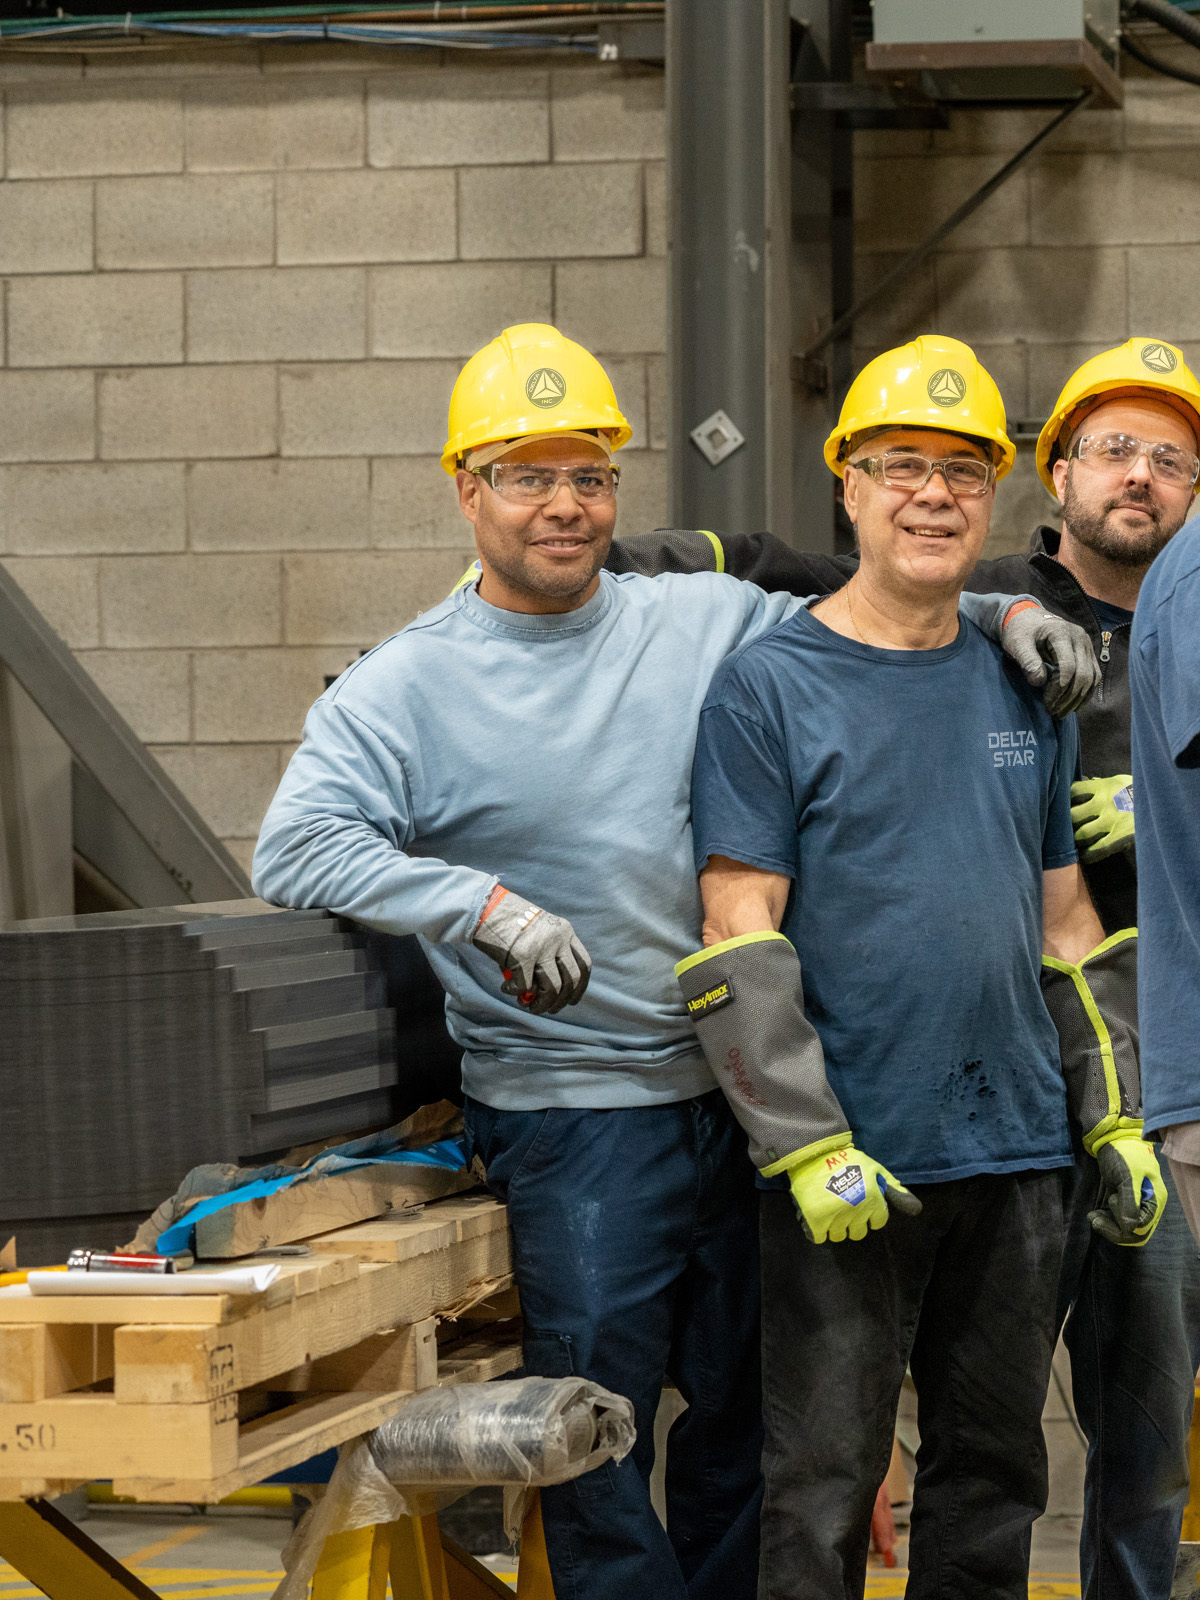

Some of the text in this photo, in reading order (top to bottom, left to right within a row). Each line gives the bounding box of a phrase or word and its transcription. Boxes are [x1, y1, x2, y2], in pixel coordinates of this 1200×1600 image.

[529, 373, 563, 392] DELTA STAR
[930, 372, 943, 390] DELTA
[987, 730, 1037, 749] DELTA
[993, 749, 1035, 768] STAR
[687, 984, 728, 1012] HexArmor
[832, 1168, 860, 1191] HELIX
